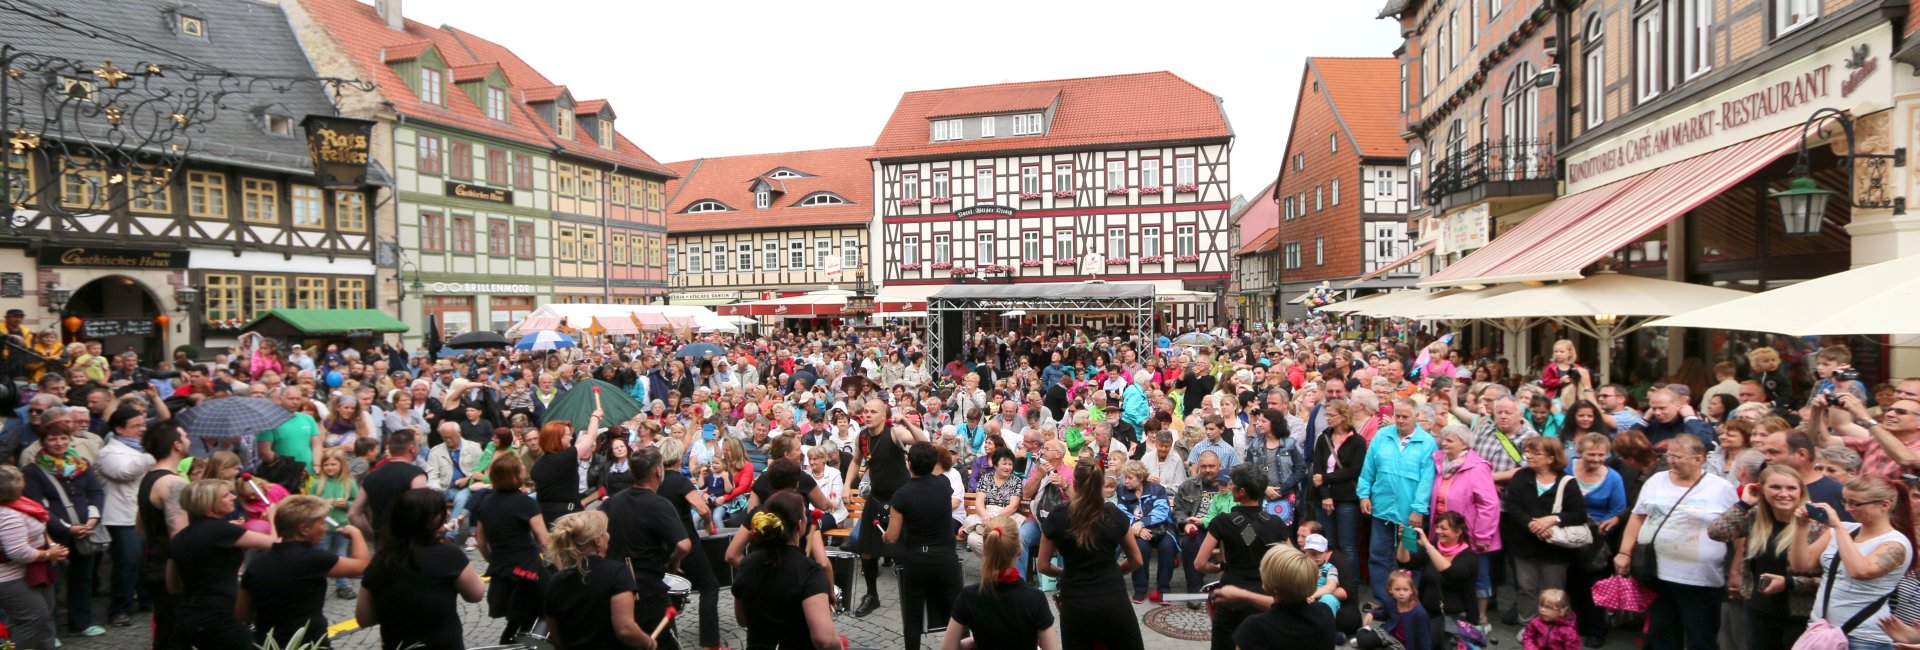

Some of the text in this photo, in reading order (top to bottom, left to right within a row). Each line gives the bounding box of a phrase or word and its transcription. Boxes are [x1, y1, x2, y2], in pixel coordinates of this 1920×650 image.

[316, 128, 368, 149] Rats
[1569, 148, 1617, 184] KONDITOREI
[1618, 145, 1625, 167] &
[1626, 128, 1651, 163] CAFÉ
[1653, 127, 1669, 155] AM
[61, 248, 170, 267] Gothisches Haus
[464, 282, 530, 293] BRILLENMODE
